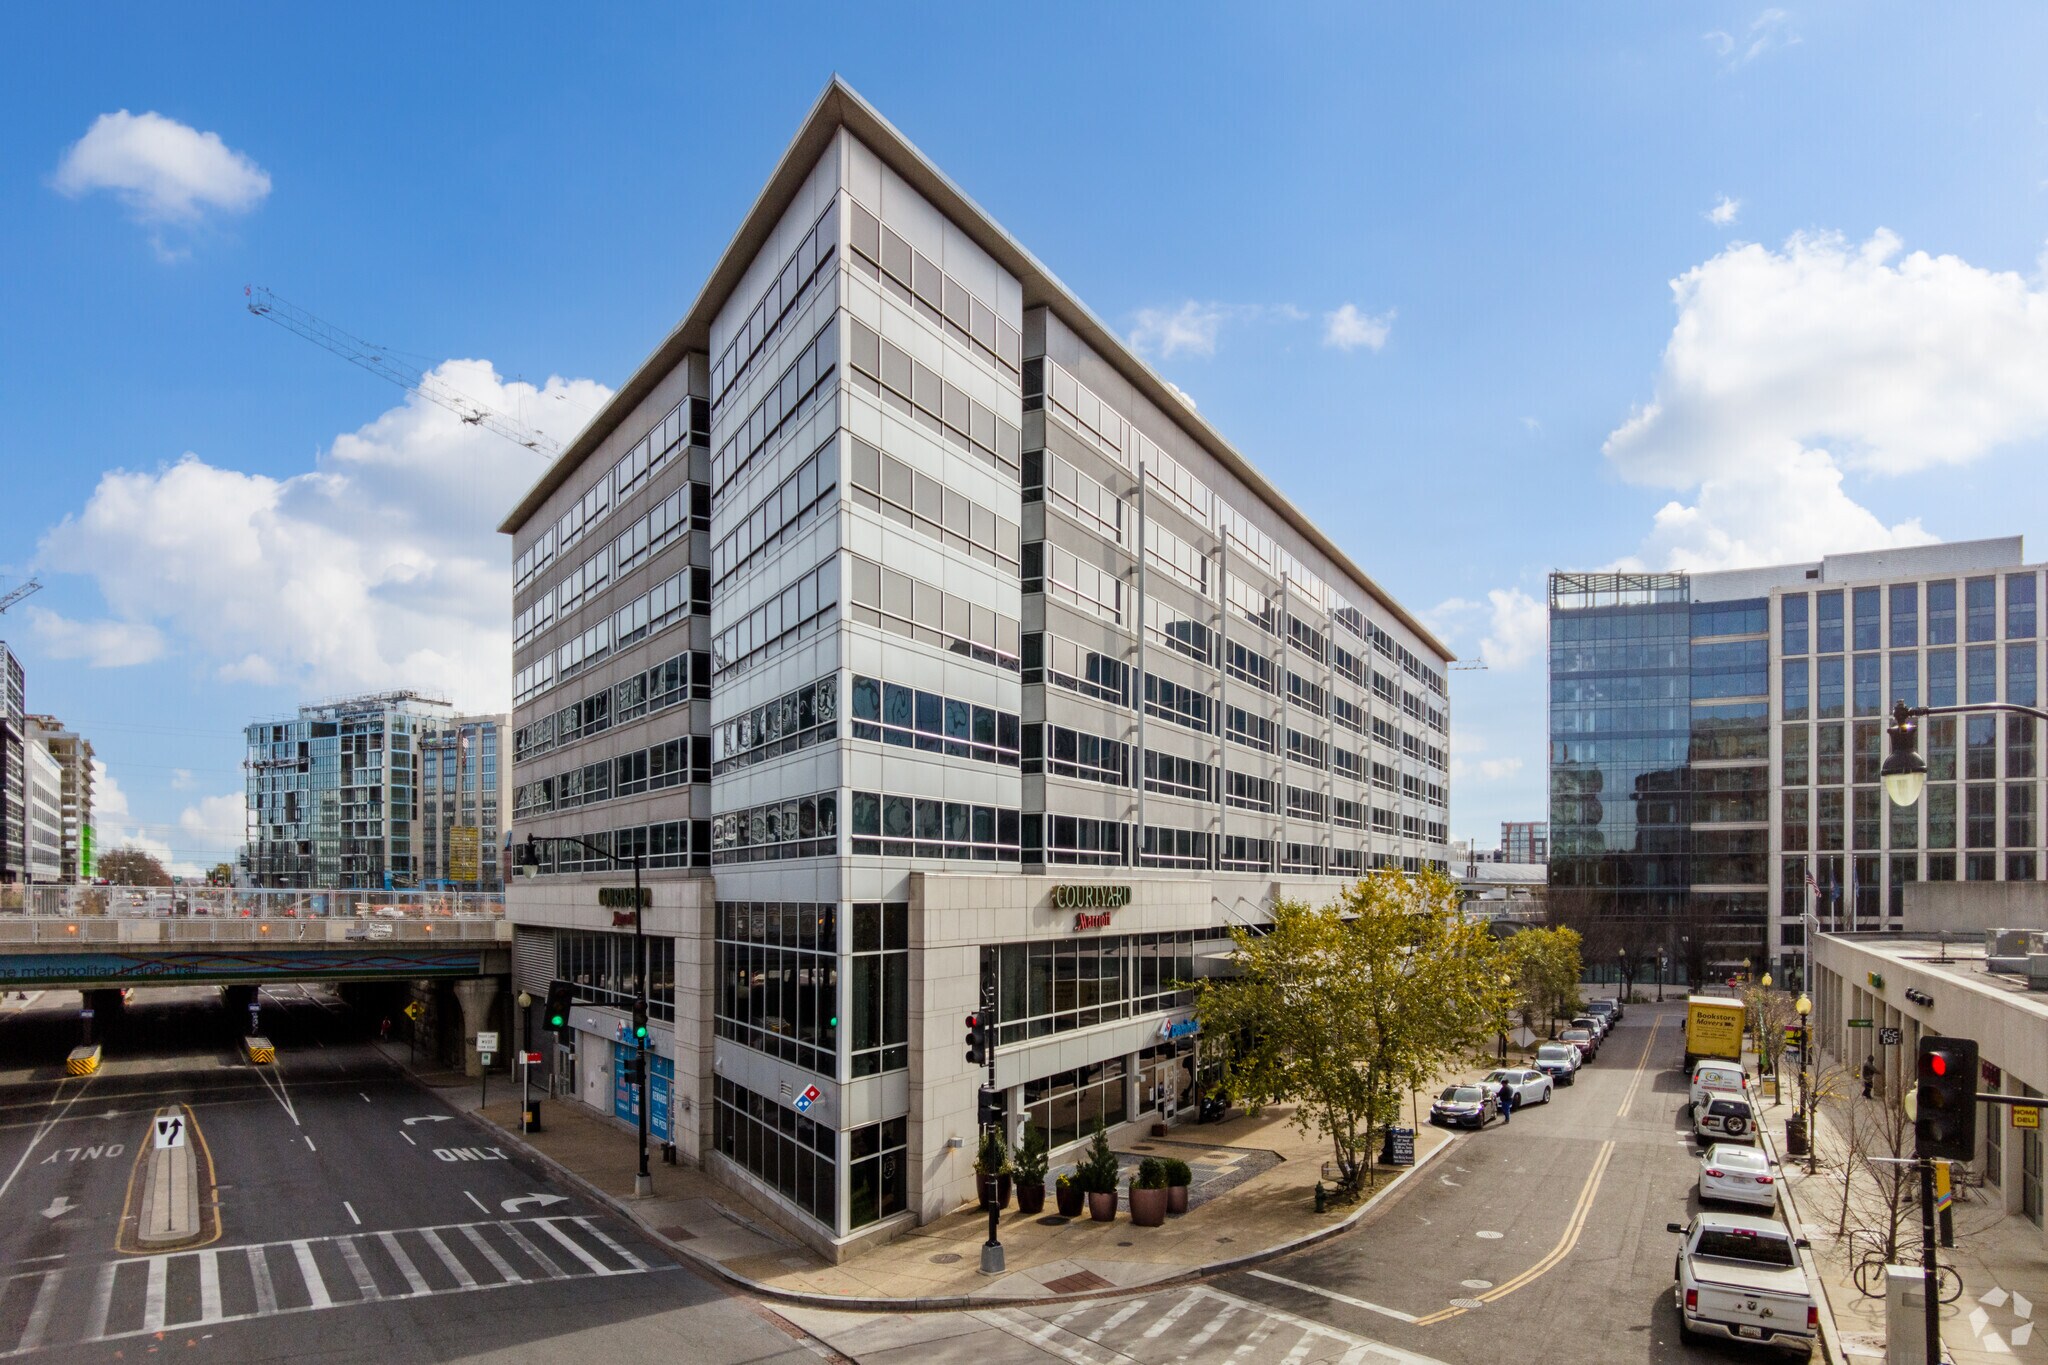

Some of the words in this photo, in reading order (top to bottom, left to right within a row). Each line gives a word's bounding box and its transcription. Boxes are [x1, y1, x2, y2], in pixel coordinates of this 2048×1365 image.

[1056, 886, 1132, 908] COURTYARD
[1074, 911, 1111, 931] Marriott
[21, 965, 116, 978] metropolitan
[121, 963, 170, 976] branch
[175, 962, 198, 975] trail
[1696, 1019, 1723, 1027] Movers
[1697, 1011, 1736, 1021] Bookstore
[1880, 1029, 1898, 1038] rice
[1883, 1034, 1898, 1045] bar
[40, 1143, 124, 1165] ONLY
[432, 1146, 509, 1161] ONLY
